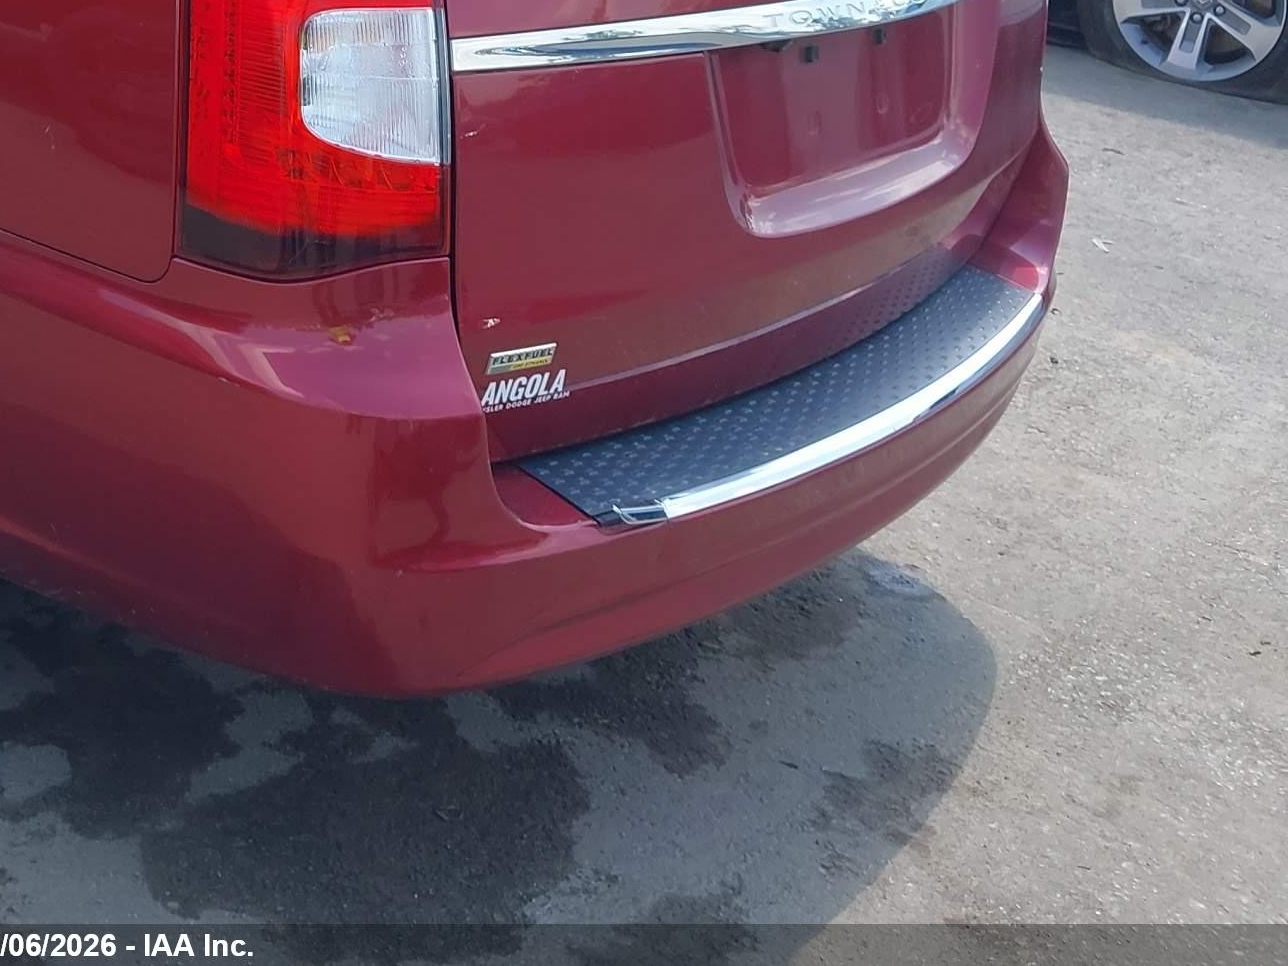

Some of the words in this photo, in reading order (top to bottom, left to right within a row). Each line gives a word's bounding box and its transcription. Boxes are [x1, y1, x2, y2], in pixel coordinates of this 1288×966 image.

[762, 0, 866, 26] TOWN
[481, 369, 567, 407] ANGOLA
[506, 398, 532, 411] DODGE
[533, 394, 551, 405] JEEP
[553, 390, 571, 401] RAM
